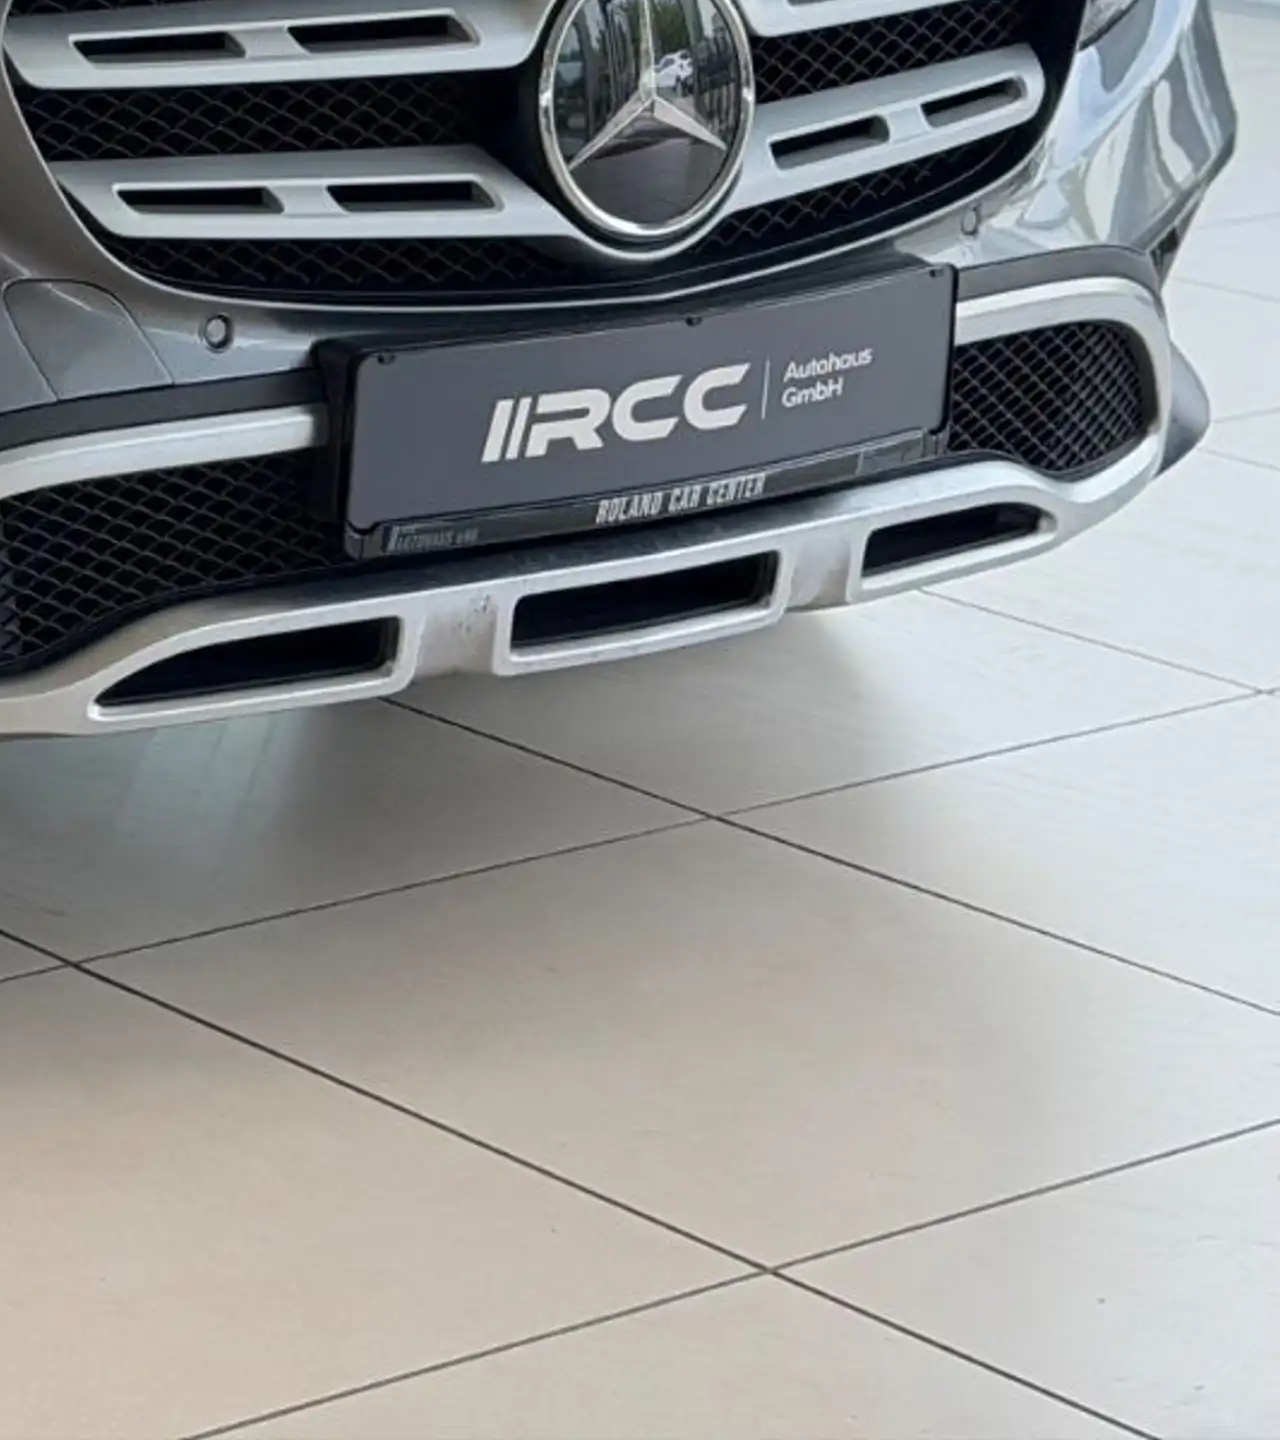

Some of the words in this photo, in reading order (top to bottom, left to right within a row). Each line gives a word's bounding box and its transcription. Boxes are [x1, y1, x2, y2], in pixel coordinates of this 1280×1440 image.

[783, 347, 873, 382] Autohaus
[782, 377, 843, 408] GmbH
[596, 492, 662, 524] ROLAND
[668, 485, 702, 512] CAR
[707, 474, 765, 505] CENTER
